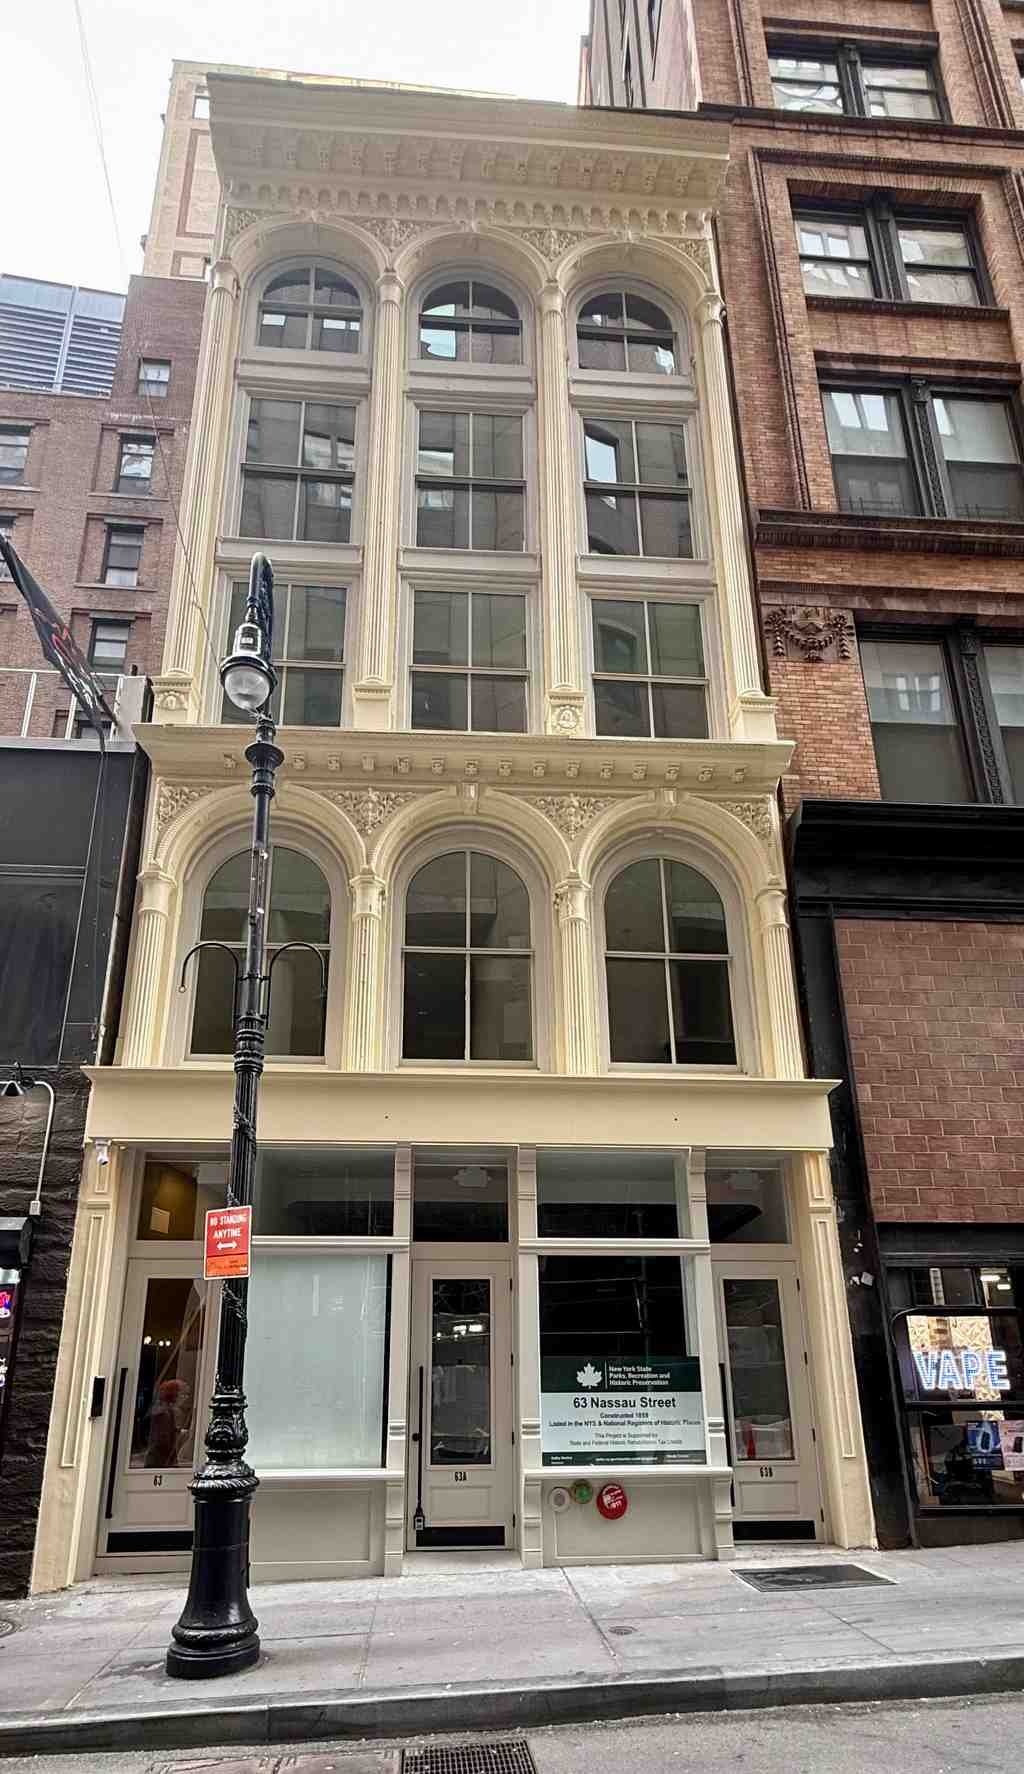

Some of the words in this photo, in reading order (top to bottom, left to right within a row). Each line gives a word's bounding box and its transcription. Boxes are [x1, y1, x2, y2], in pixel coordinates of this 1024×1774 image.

[210, 1216, 218, 1226] NO
[220, 1214, 247, 1225] STANDING
[213, 1228, 241, 1238] ANYTIME
[659, 1371, 670, 1379] and
[912, 1349, 1011, 1391] VAPE
[633, 1379, 669, 1387] Preservation
[573, 1397, 587, 1408] 63
[591, 1397, 636, 1408] Nassau
[640, 1396, 676, 1408] Street
